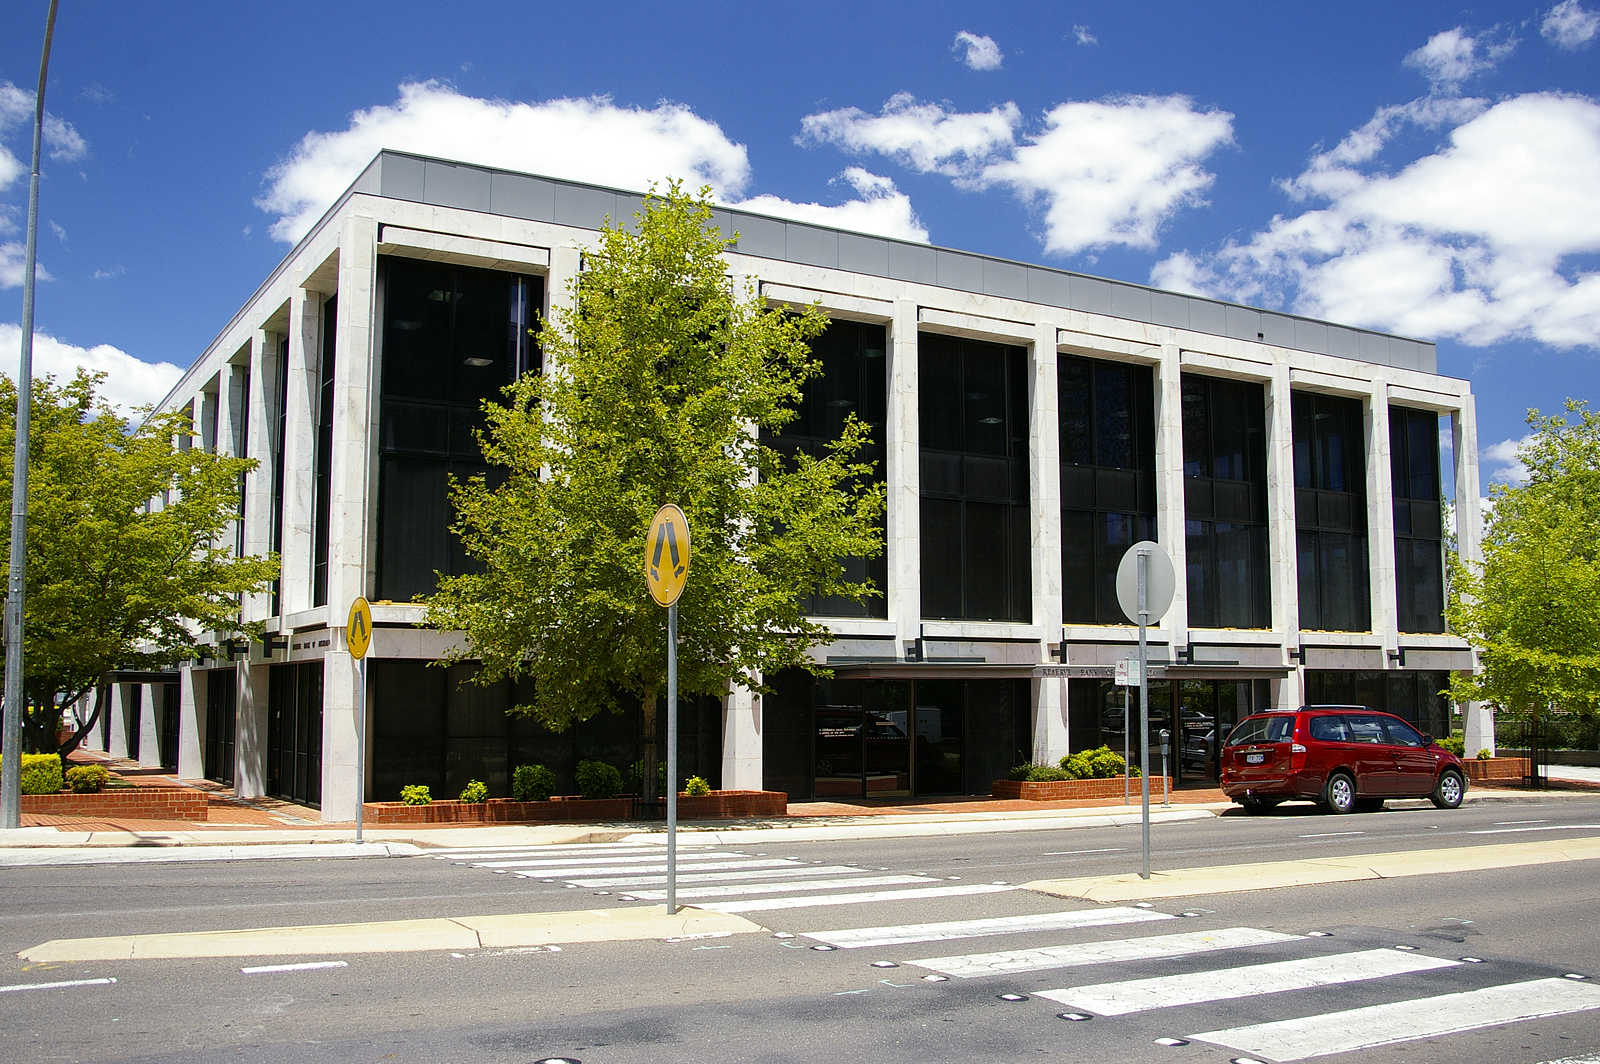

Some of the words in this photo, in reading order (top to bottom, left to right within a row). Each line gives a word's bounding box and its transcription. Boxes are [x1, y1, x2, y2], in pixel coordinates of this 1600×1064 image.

[1042, 668, 1072, 677] RESERVE
[1081, 668, 1099, 677] BANK
[1105, 668, 1114, 676] OF
